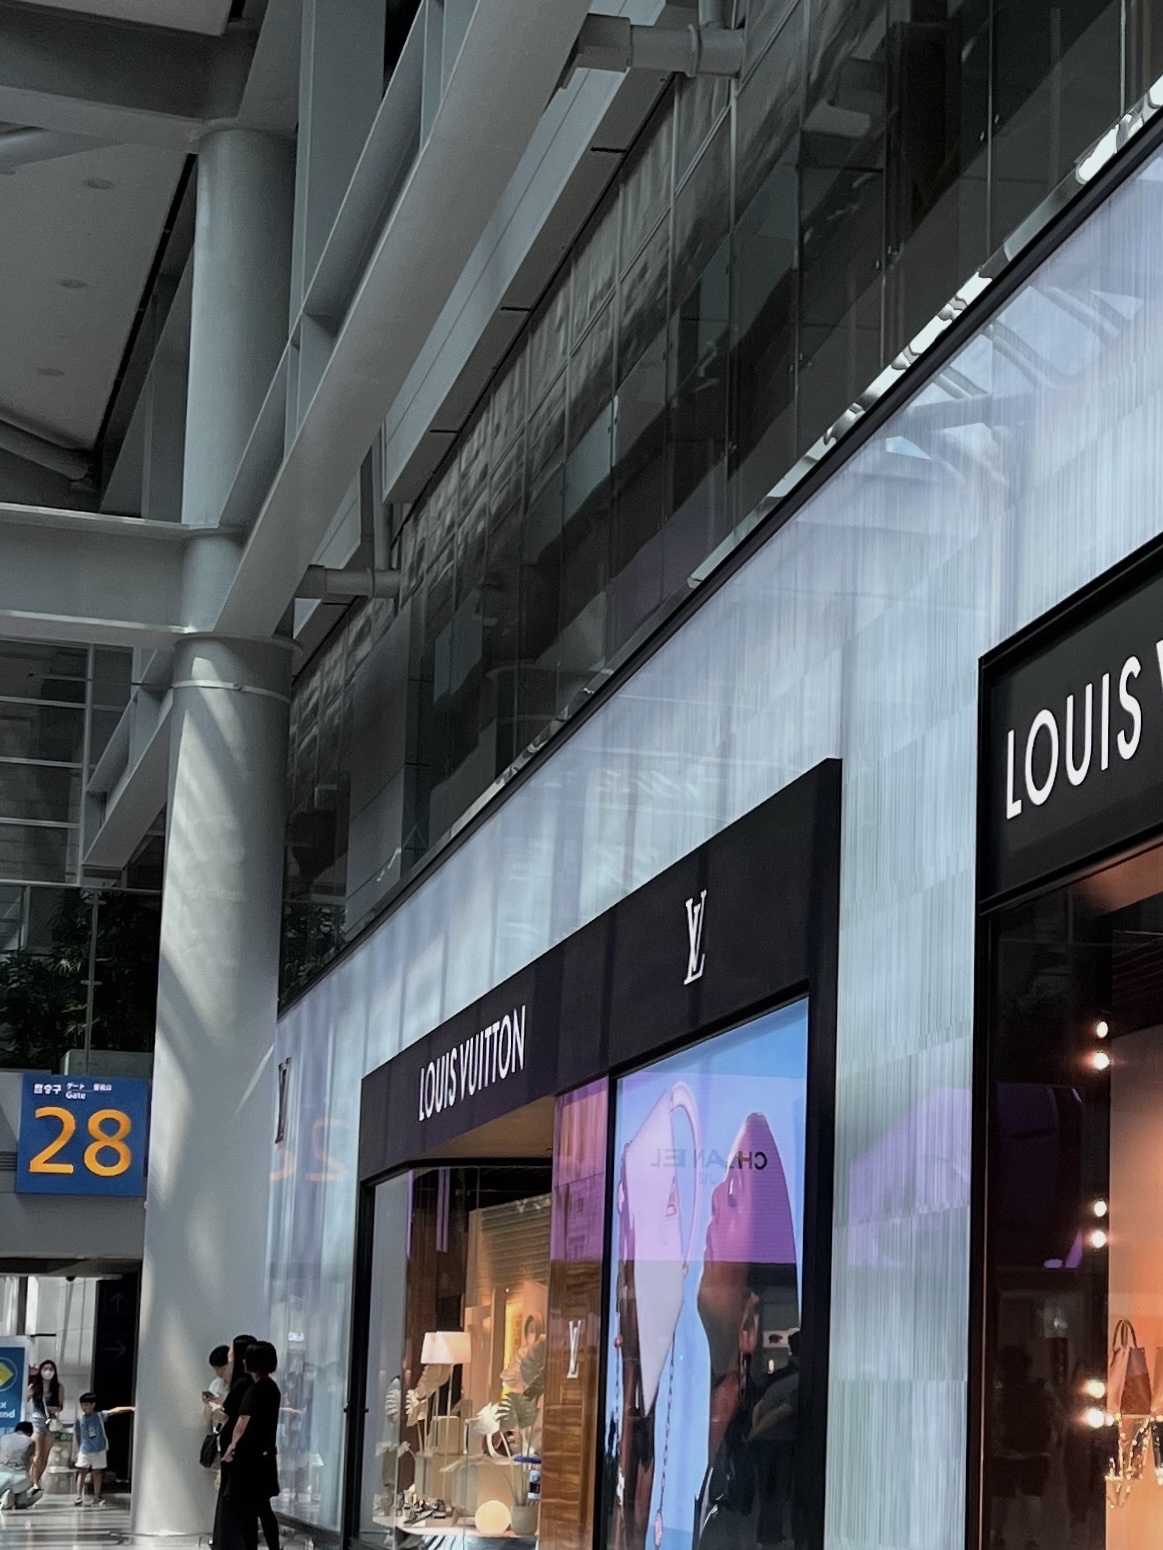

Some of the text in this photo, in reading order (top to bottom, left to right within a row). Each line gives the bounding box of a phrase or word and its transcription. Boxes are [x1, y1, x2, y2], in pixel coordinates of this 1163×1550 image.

[1006, 655, 1142, 820] LOUIS
[65, 1090, 87, 1100] Gate
[419, 1004, 526, 1122] LOUIS VUITTON
[29, 1106, 132, 1177] 28
